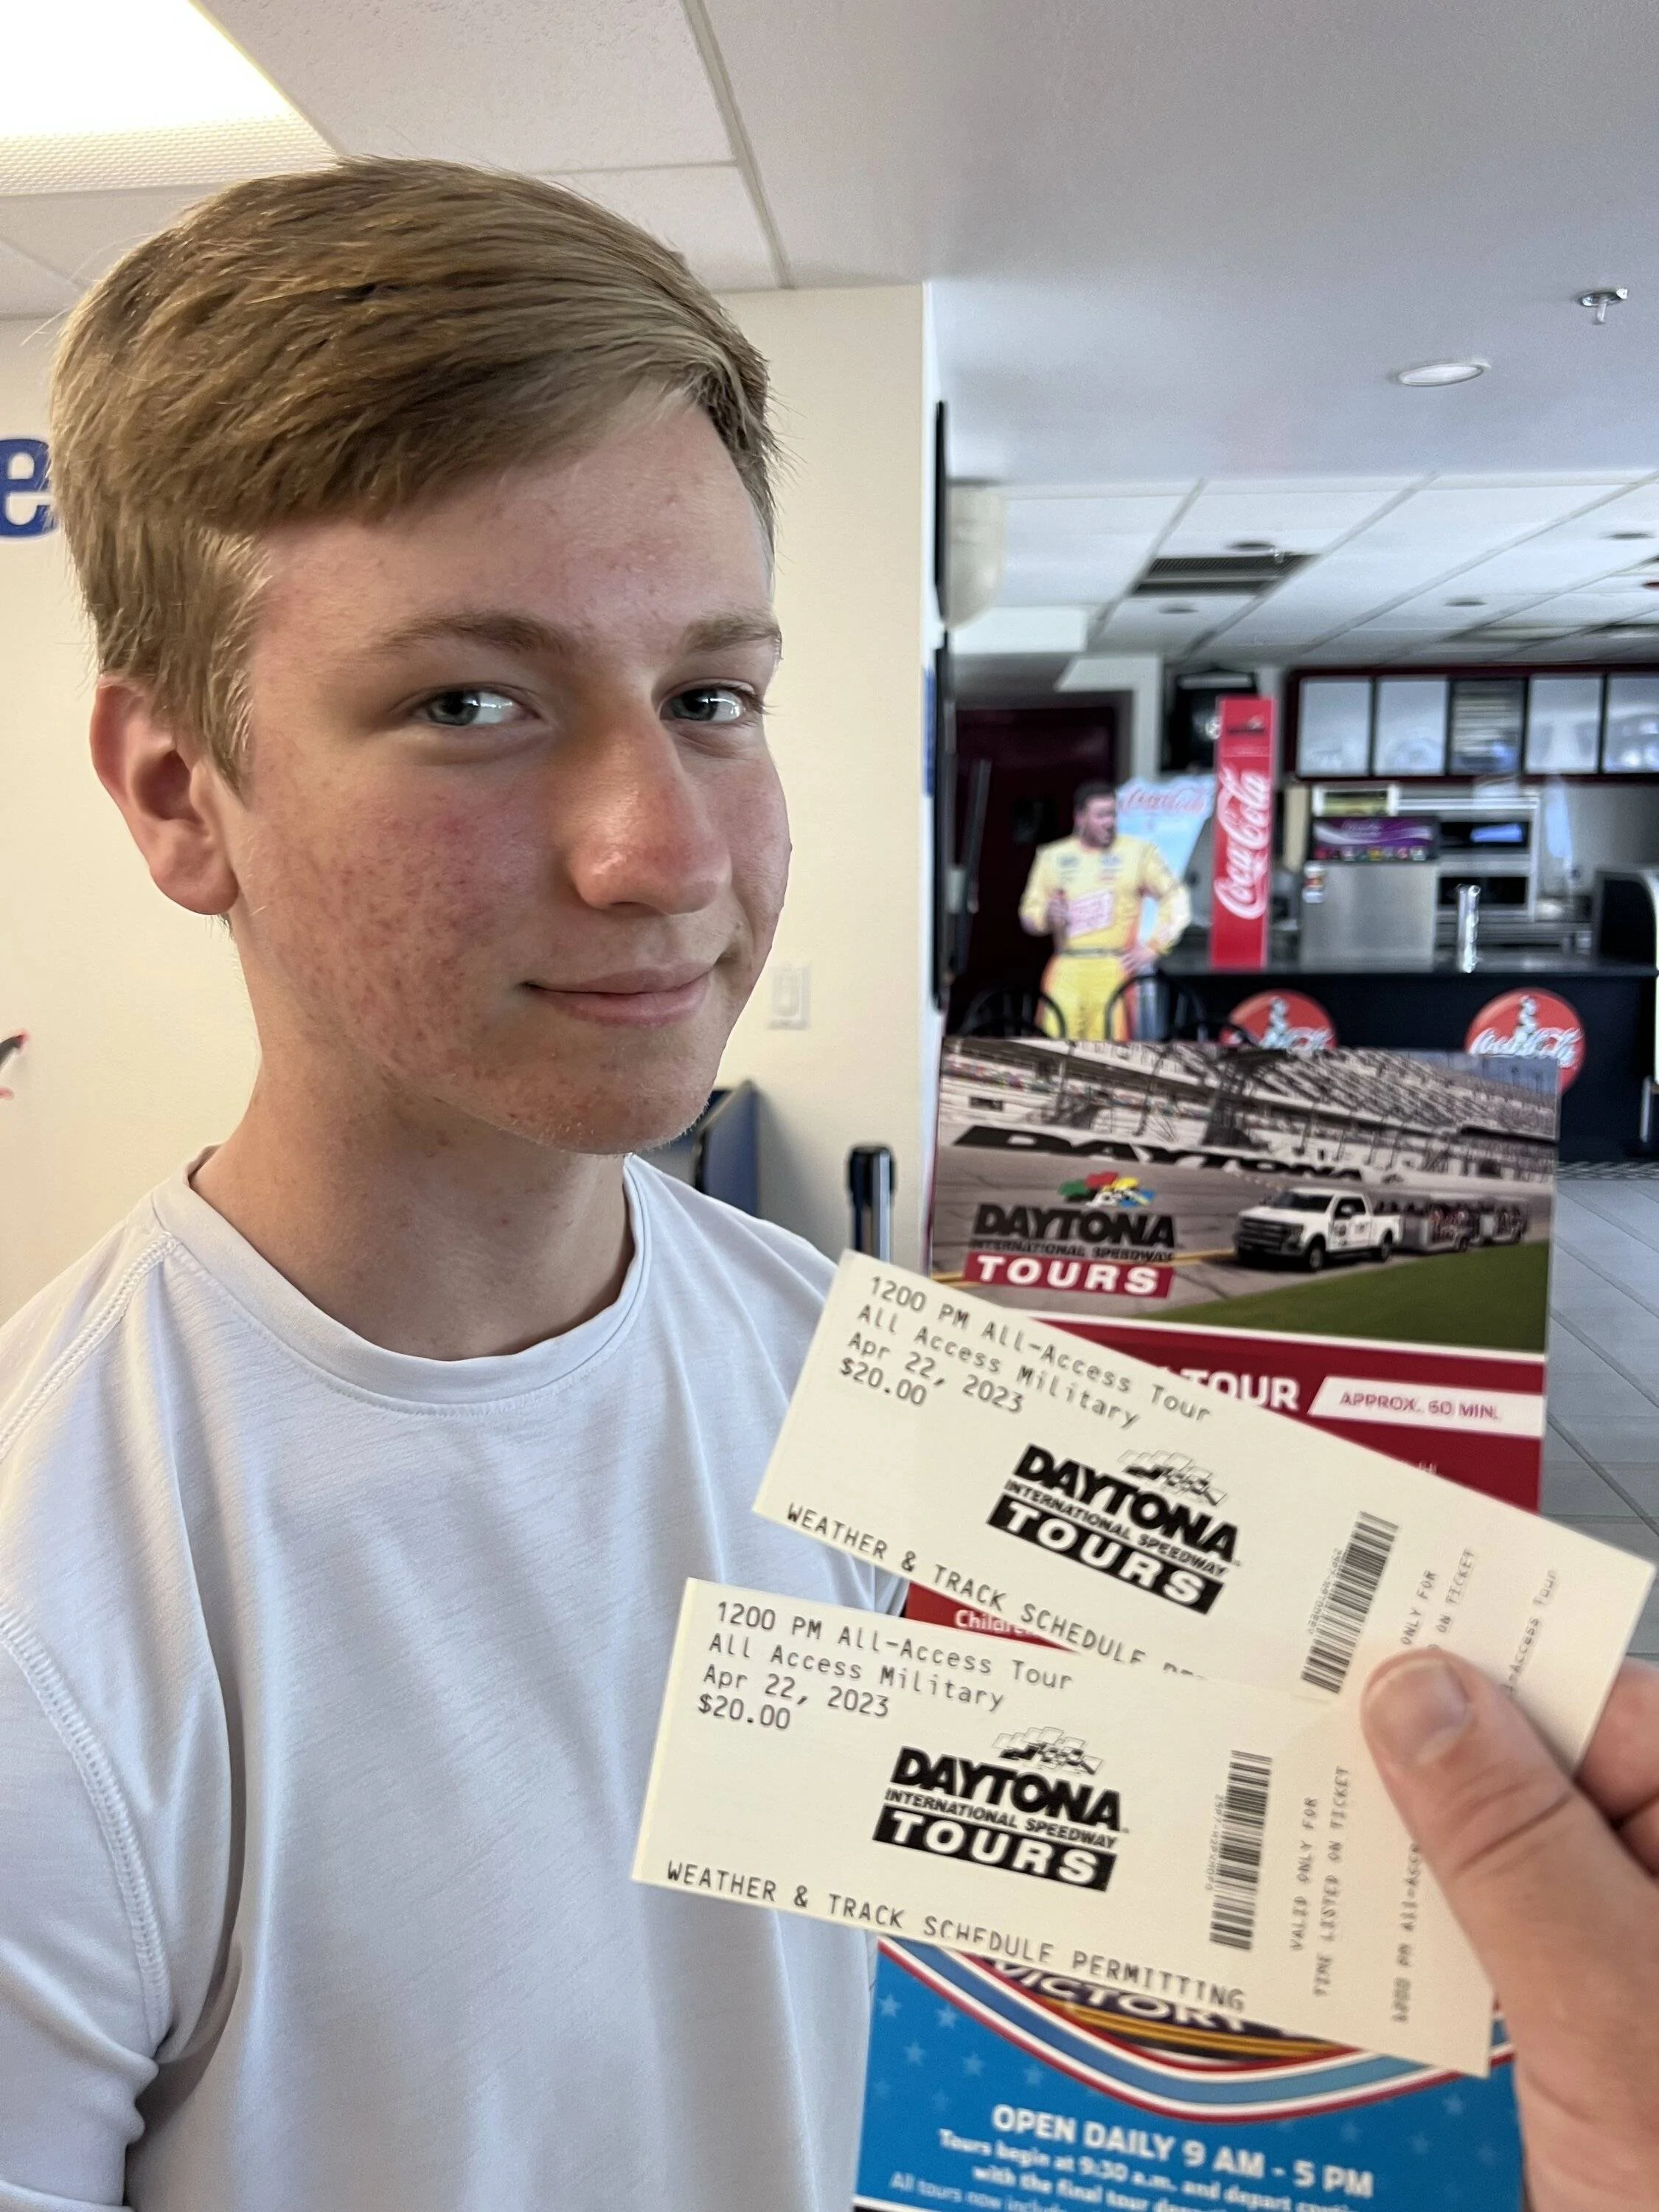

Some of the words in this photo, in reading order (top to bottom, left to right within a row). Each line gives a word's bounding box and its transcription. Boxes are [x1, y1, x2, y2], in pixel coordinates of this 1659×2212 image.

[1214, 765, 1270, 919] Coca-Cola
[969, 1238, 1085, 1257] INTERNATIONAL
[1092, 1246, 1174, 1262] SPEEDWAY
[974, 1203, 1175, 1248] DAYTONA
[977, 1255, 1158, 1295] TOURS
[840, 1357, 926, 1405] $20.00
[848, 1332, 891, 1363] Apr
[905, 1352, 946, 1386] 22,
[962, 1375, 1023, 1413] 2023
[858, 1304, 896, 1334] All
[914, 1327, 1001, 1373] Access
[1017, 1366, 1140, 1428] Military
[870, 1276, 926, 1311] 1200
[939, 1303, 969, 1329] PM
[982, 1319, 1131, 1393] All-Access
[1151, 1385, 1210, 1421] Tour
[1340, 1391, 1422, 1414] APPROX.
[1459, 1402, 1499, 1420] MIN.
[1005, 1480, 1132, 1541] INTERNATIONAL
[1138, 1534, 1228, 1576] SPEEDWAY
[1012, 1444, 1239, 1562] DAYTONA
[787, 1503, 888, 1559] WEATHER
[900, 1551, 917, 1572] &
[935, 1564, 1006, 1611] TRACK
[1004, 1500, 1207, 1606] TOURS
[1445, 1548, 1475, 1604] TICKET
[1402, 1607, 1419, 1646] ONLY
[1418, 1569, 1438, 1600] FOR
[709, 1632, 751, 1659] All
[771, 1644, 861, 1680] Access
[880, 1664, 1005, 1713] Military
[717, 1601, 776, 1632] 1200
[793, 1615, 822, 1641] PM
[838, 1626, 992, 1674] All-Access
[1011, 1660, 1072, 1691] Tour
[698, 1694, 791, 1731] $20.00
[703, 1664, 747, 1691] Apr
[765, 1673, 808, 1705] 22,
[827, 1686, 890, 1718] 2023
[884, 1787, 1018, 1829] INTERNATIONAL
[1023, 1816, 1117, 1848] SPEEDWAY
[889, 1746, 1121, 1832] DAYTONA
[1303, 1797, 1319, 1829] FOR
[1331, 1766, 1351, 1830] TICKET
[888, 1811, 1100, 1886] TOURS
[1297, 1840, 1312, 1883] ONLY
[667, 1860, 777, 1904] WEATHER
[794, 1885, 809, 1908] &
[829, 1893, 904, 1930] TRACK
[924, 1915, 1054, 1964] SCHEDULE
[1072, 1950, 1246, 2012] PERMITTING
[1290, 1897, 1308, 1950] VALID
[939, 2128, 992, 2156] Tours
[995, 2140, 1050, 2168] begin
[992, 2104, 1077, 2143] OPEN
[1083, 2121, 1175, 2161] DAILY
[1182, 2140, 1206, 2167] 9
[1213, 2146, 1265, 2178] AM
[1293, 2160, 1315, 2188] 5
[1322, 2164, 1374, 2199] PM
